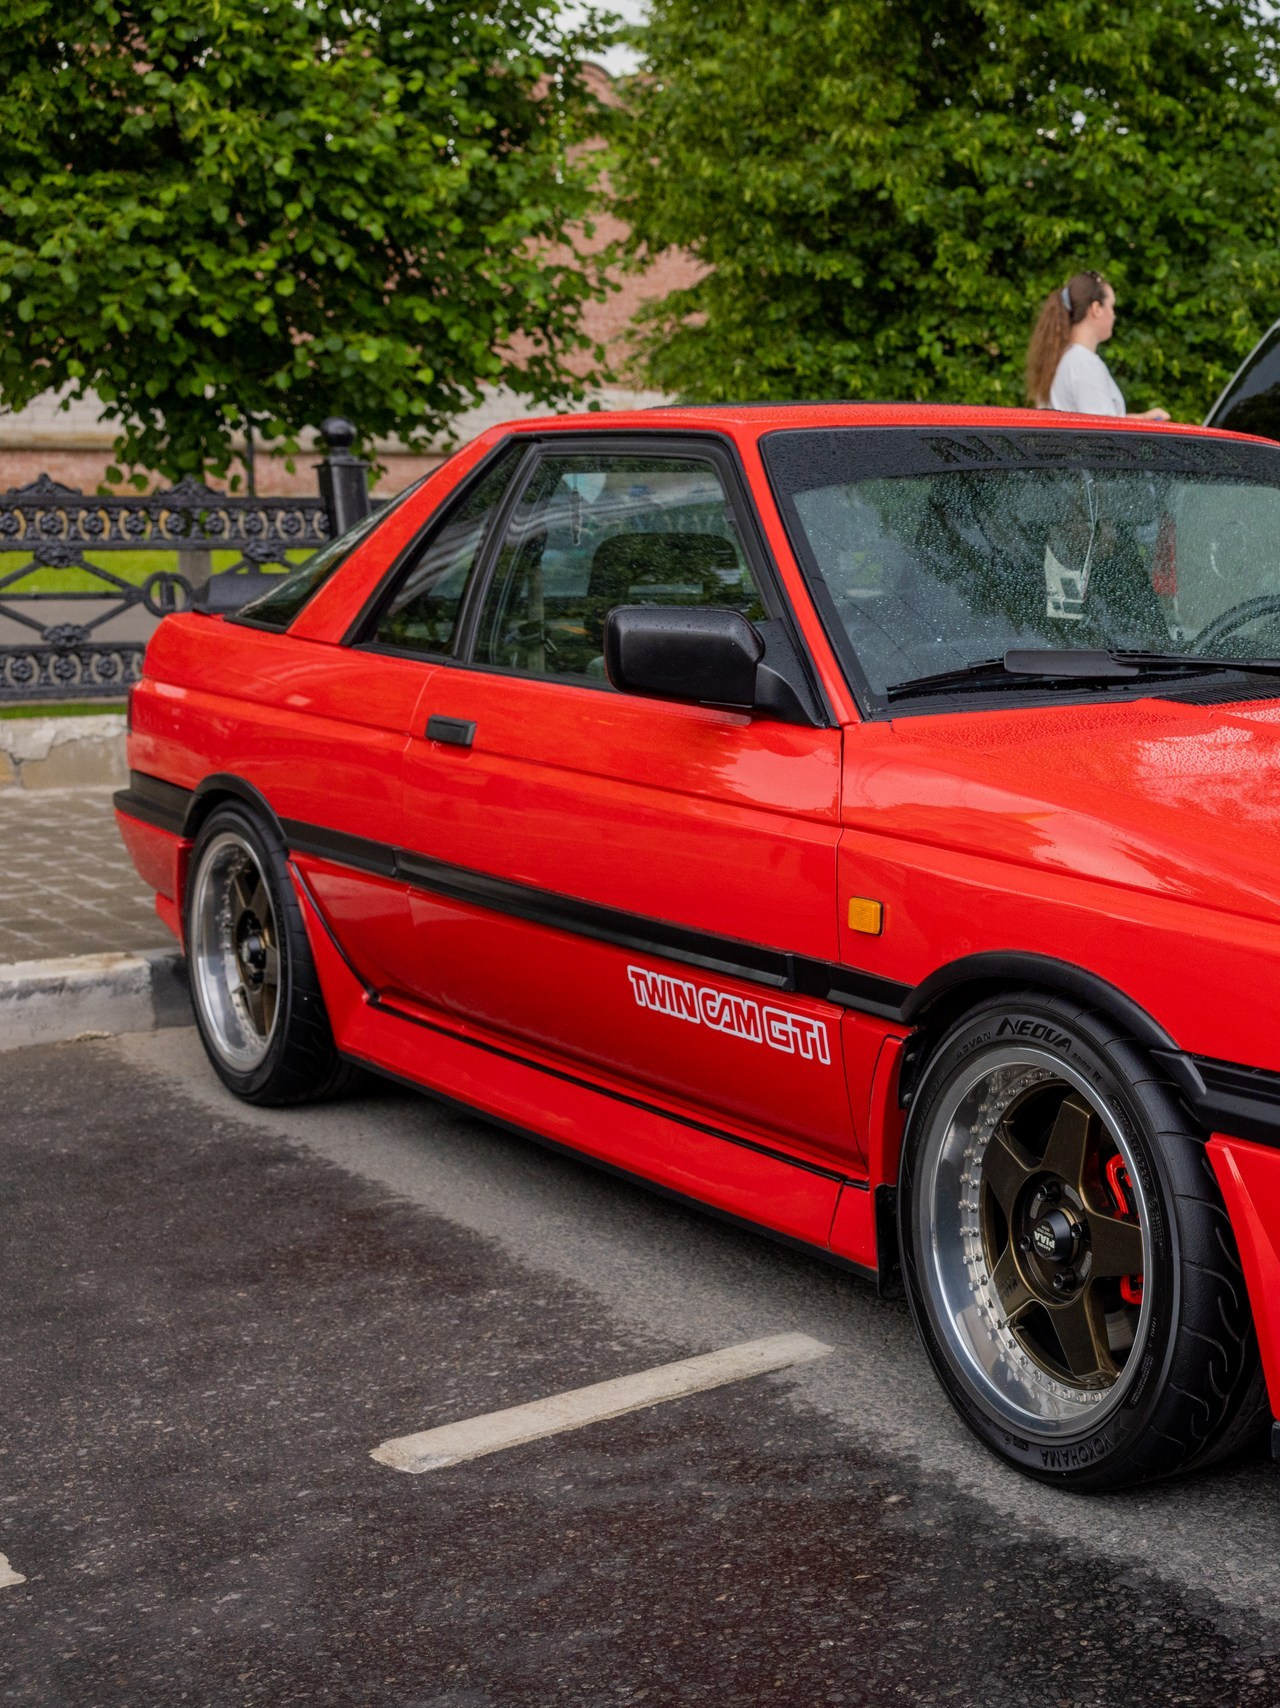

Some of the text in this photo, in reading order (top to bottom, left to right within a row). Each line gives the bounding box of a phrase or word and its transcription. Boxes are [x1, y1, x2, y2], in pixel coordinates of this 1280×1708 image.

[627, 965, 831, 1065] TWIN CAM GTI
[996, 1017, 1073, 1053] NEOVA
[1034, 1230, 1056, 1249] PIAA
[1040, 1432, 1114, 1468] YOKOHAMA
